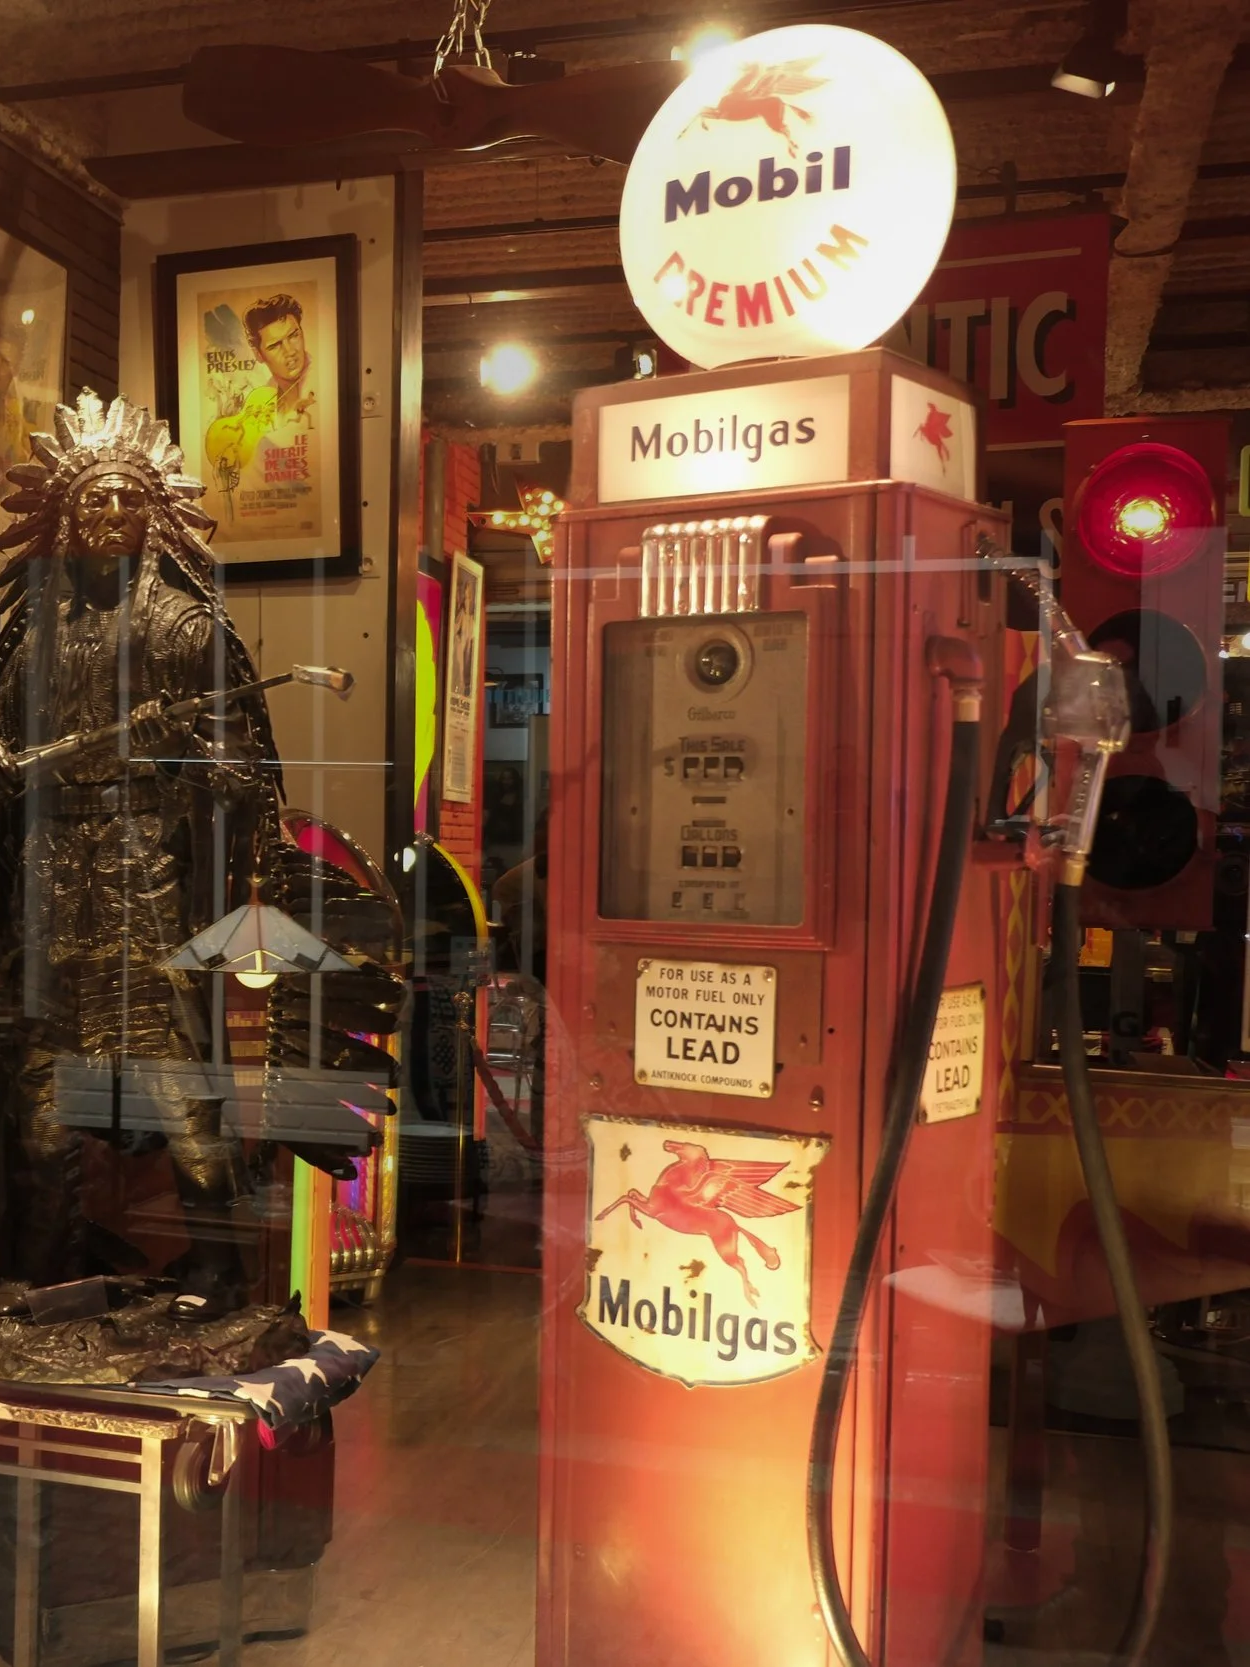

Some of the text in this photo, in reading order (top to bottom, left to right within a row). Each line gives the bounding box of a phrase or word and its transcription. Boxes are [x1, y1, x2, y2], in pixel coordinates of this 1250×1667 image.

[664, 145, 851, 223] Mobil
[653, 223, 869, 328] PREMIUM
[206, 349, 236, 362] ELVIS
[207, 360, 256, 374] PRESLEY
[630, 415, 817, 463] Mobilgas
[660, 967, 751, 986] FOR USE AS A
[646, 985, 765, 1006] MOTOR FUEL ONLY
[650, 1008, 759, 1035] CONTAINS
[667, 1036, 740, 1065] LEAD
[929, 1035, 978, 1061] CONTAINS
[651, 1069, 752, 1089] ANTIKNOCK COMPOUNDS
[936, 1064, 970, 1094] LEAD
[597, 1274, 798, 1362] Mobilgas
